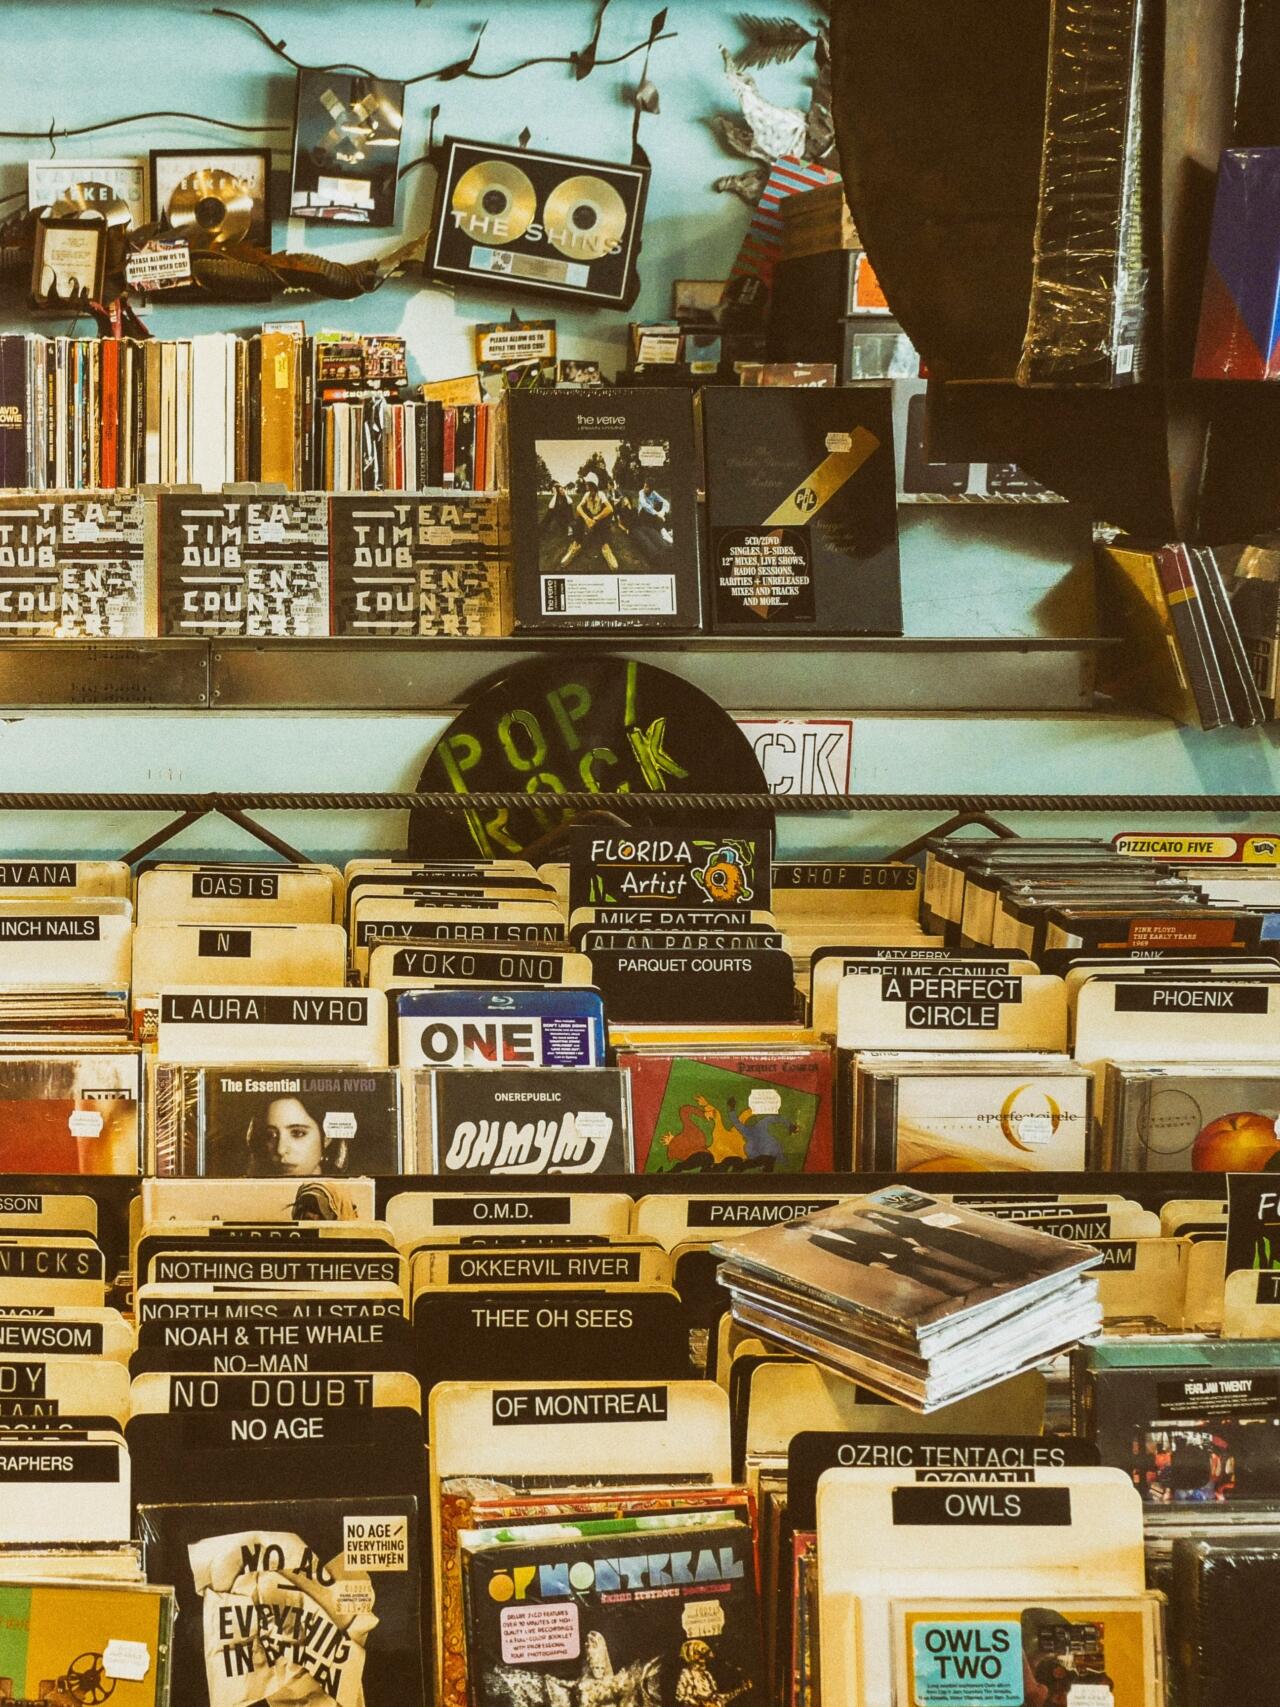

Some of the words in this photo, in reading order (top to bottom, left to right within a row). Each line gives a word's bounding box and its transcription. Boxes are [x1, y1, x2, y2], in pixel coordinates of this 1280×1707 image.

[451, 211, 508, 236] THE
[525, 224, 622, 254] SHINS
[577, 415, 594, 425] the
[597, 416, 625, 425] verve
[745, 536, 780, 546] 5CD/2DVD
[182, 546, 241, 568] DUB
[352, 546, 413, 568] DUB
[730, 546, 763, 556] SINGLES,
[763, 546, 796, 556] B-SIDES,
[734, 557, 760, 566] MIXES,
[760, 556, 777, 565] LIVE
[778, 556, 806, 565] SHOWS,
[733, 566, 756, 575] RADIO
[757, 566, 795, 576] SESSIONS,
[720, 577, 753, 586] RARITIES
[762, 576, 810, 585] UNRELEASED
[731, 587, 754, 596] MIXES
[755, 587, 770, 596] AND
[771, 586, 800, 596] TRACKS
[591, 840, 693, 863] FLORIDA
[1118, 841, 1183, 853] PIZZICATO
[1187, 841, 1214, 853] FIVE
[200, 877, 274, 896] OASIS
[621, 872, 687, 895] Artist
[1, 920, 41, 936] INCH
[46, 920, 95, 936] NAILS
[405, 953, 475, 976] YOKO
[500, 956, 553, 980] ONO
[618, 959, 687, 973] PARQUET
[691, 958, 752, 972] COURTS
[885, 979, 902, 998] A
[910, 979, 1019, 999] PERFECT
[1153, 990, 1234, 1008] PHOENIX
[172, 998, 259, 1021] LAURA
[293, 999, 363, 1022] NYRO
[909, 1006, 996, 1027] CIRCLE
[420, 1023, 535, 1063] ONE
[221, 1079, 243, 1092] The
[245, 1079, 300, 1092] Essential
[303, 1079, 341, 1092] LAURA
[343, 1079, 376, 1093] NYRO
[494, 1092, 562, 1102] ONEREPUBLIC
[472, 1203, 534, 1219] O.M.D.
[160, 1262, 253, 1280] NOTHING
[260, 1263, 301, 1280] BUT
[307, 1263, 394, 1281] THIEVES
[460, 1259, 561, 1277] OKKERVIL
[567, 1258, 630, 1276] RIVER
[471, 1309, 529, 1328] THEE
[536, 1309, 568, 1328] OH
[575, 1309, 633, 1328] SEES
[165, 1327, 228, 1346] NOAH
[235, 1328, 249, 1346] &
[255, 1327, 299, 1345] THE
[306, 1325, 384, 1343] WHALE
[174, 1380, 218, 1408] NO
[251, 1379, 370, 1407] DOUBT
[495, 1396, 528, 1418] OF
[535, 1393, 665, 1417] MONTREAL
[231, 1420, 267, 1441] NO
[273, 1417, 325, 1439] AGE
[837, 1444, 914, 1466] OZRIC
[920, 1446, 1066, 1468] TENTACLES
[945, 1494, 1022, 1517] OWLS
[347, 1525, 365, 1538] NO
[368, 1524, 391, 1538] AGE
[347, 1540, 405, 1552] EVERYTHING
[925, 1629, 1010, 1653] OWLS
[933, 1655, 1002, 1679] TWO
